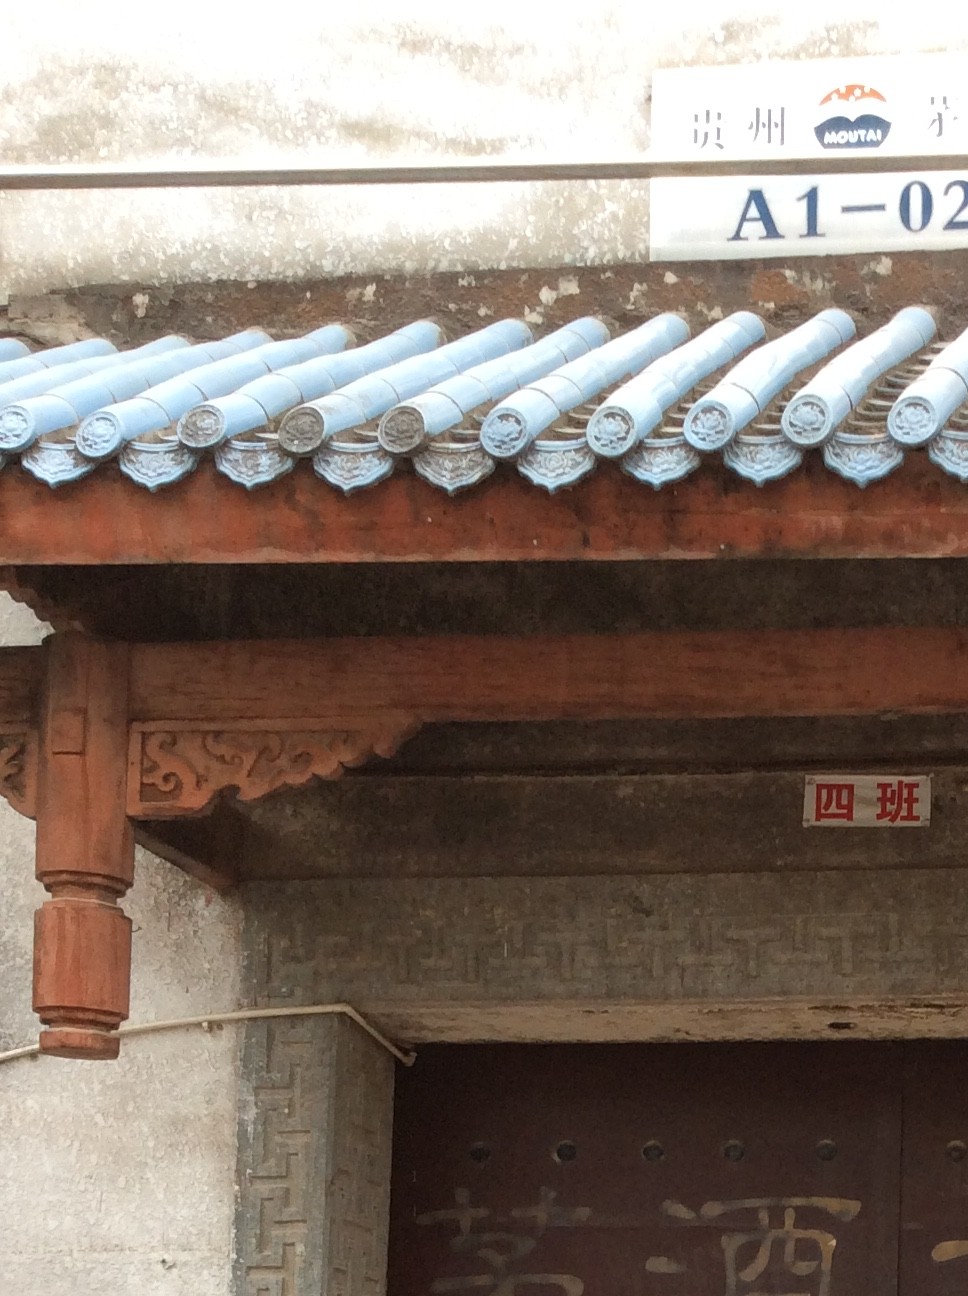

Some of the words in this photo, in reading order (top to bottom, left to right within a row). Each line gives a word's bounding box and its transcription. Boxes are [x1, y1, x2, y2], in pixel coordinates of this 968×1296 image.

[693, 106, 786, 149] 贵州
[823, 128, 883, 145] MOUTAI
[814, 780, 921, 824] 四班
